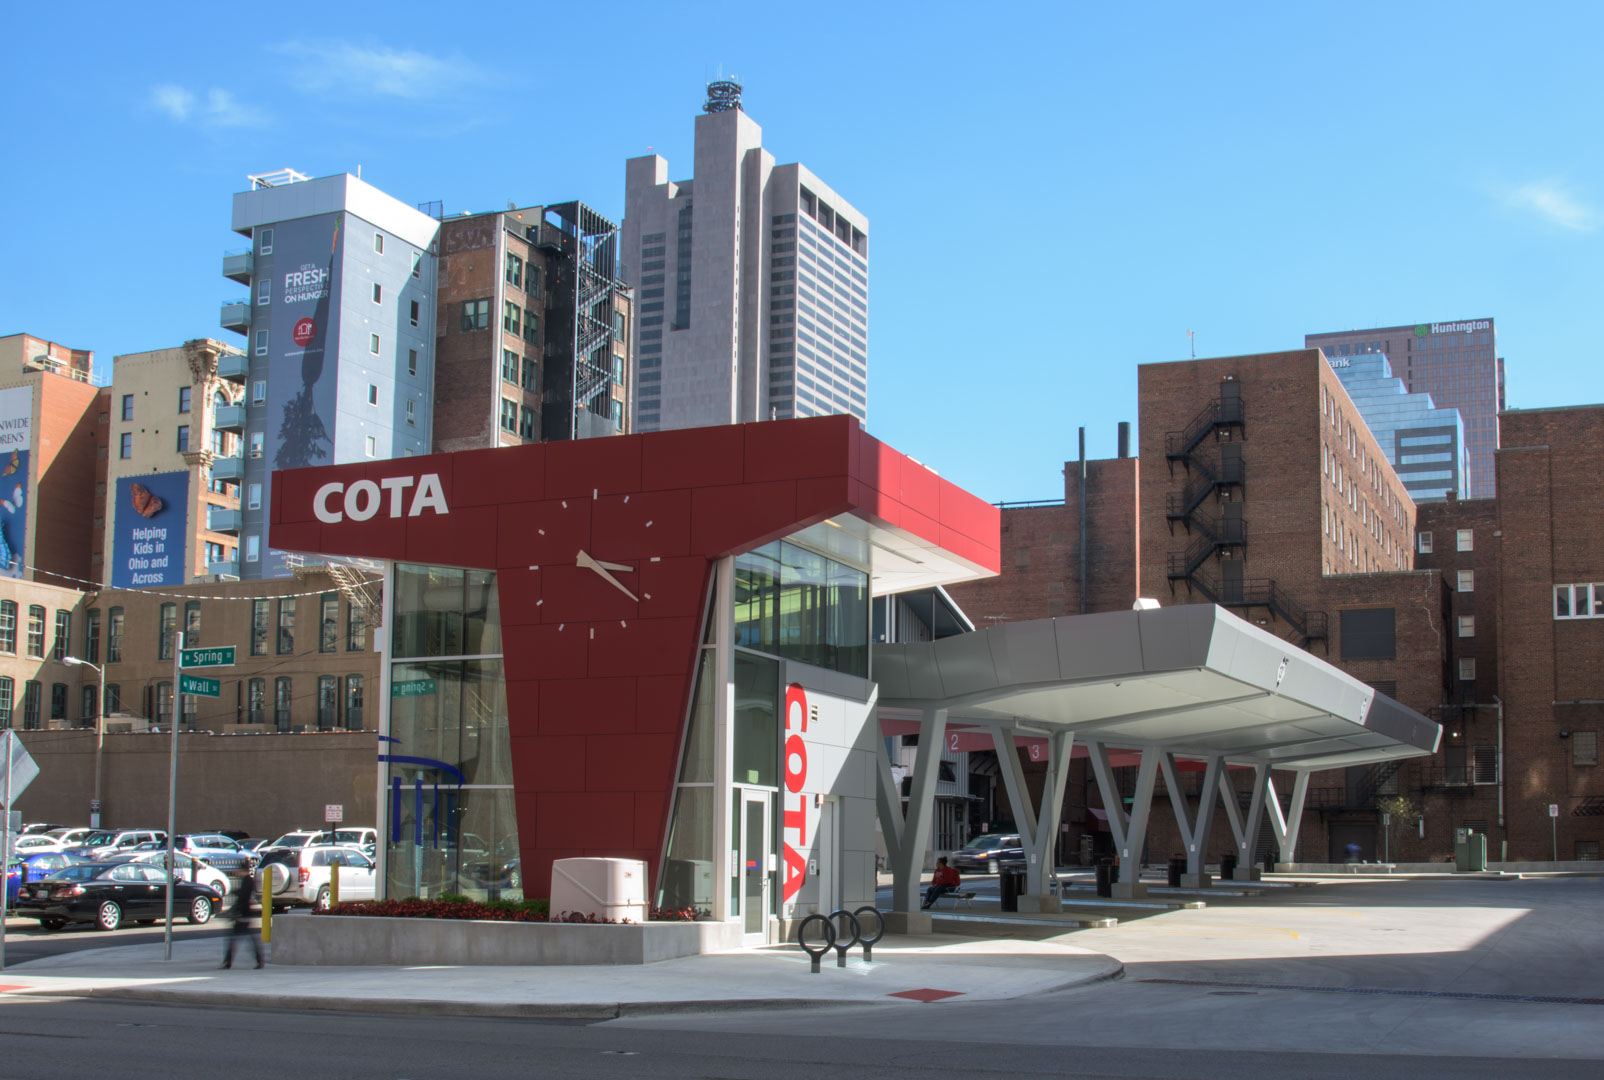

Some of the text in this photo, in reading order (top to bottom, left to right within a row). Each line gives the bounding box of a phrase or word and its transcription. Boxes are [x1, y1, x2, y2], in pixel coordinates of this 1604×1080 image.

[285, 267, 329, 288] FRESH
[284, 289, 329, 304] ON HUNGER
[1432, 320, 1490, 334] Huntington
[313, 473, 449, 524] COTA
[132, 526, 167, 541] Helping
[133, 541, 165, 555] Kids in
[128, 555, 169, 570] Ohio and
[132, 572, 164, 584] Across
[193, 650, 223, 665] Spring
[189, 680, 209, 693] Wall
[951, 734, 959, 750] 2
[1032, 744, 1041, 760] 3
[783, 682, 808, 904] COTA
